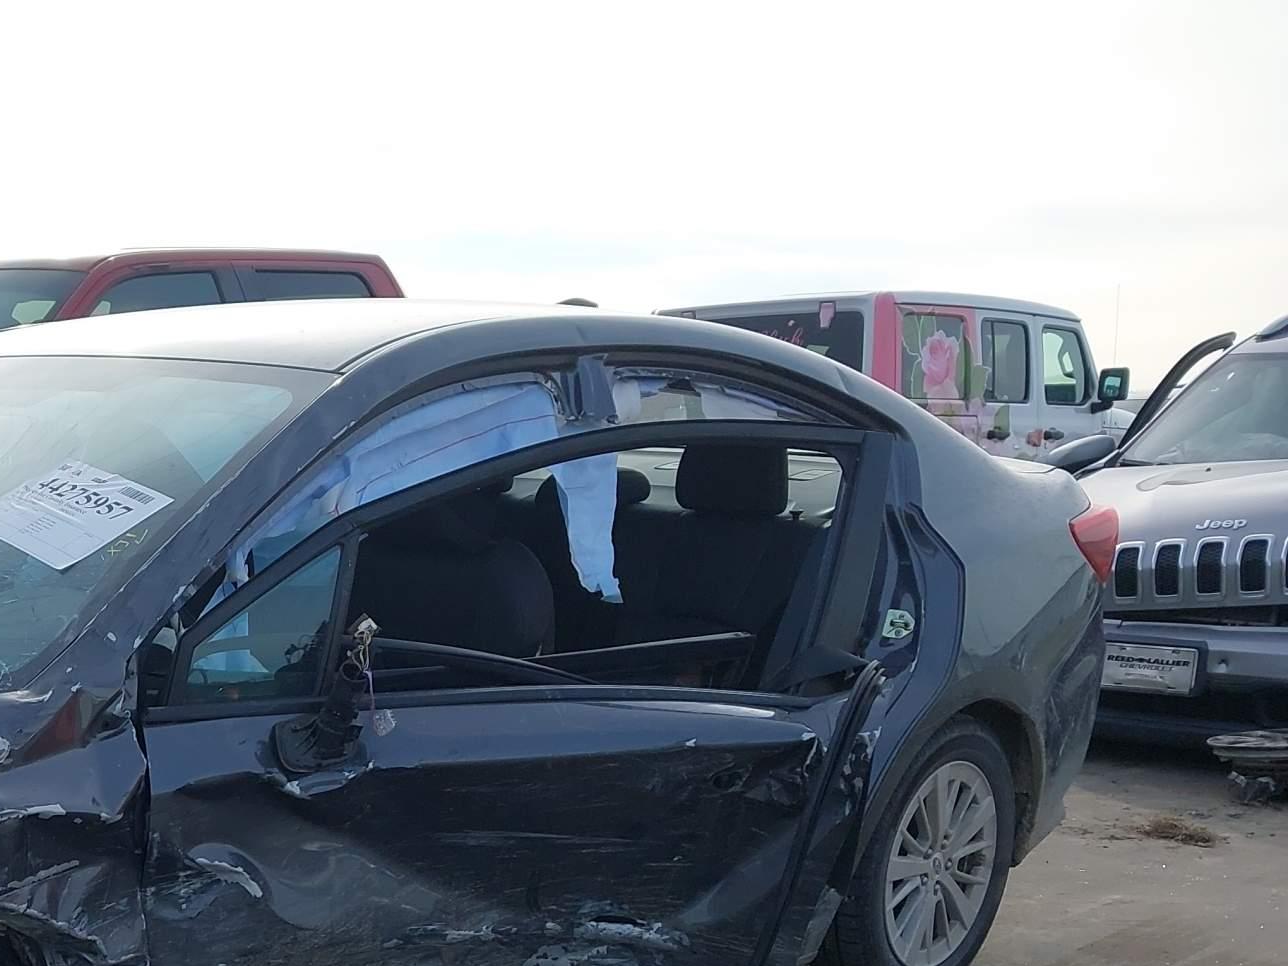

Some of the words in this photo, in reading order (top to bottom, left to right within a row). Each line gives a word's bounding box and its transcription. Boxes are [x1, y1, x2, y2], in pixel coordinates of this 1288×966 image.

[38, 478, 134, 520] 44275957
[1195, 519, 1248, 531] Jeep
[1120, 663, 1174, 671] CHEVROLET
